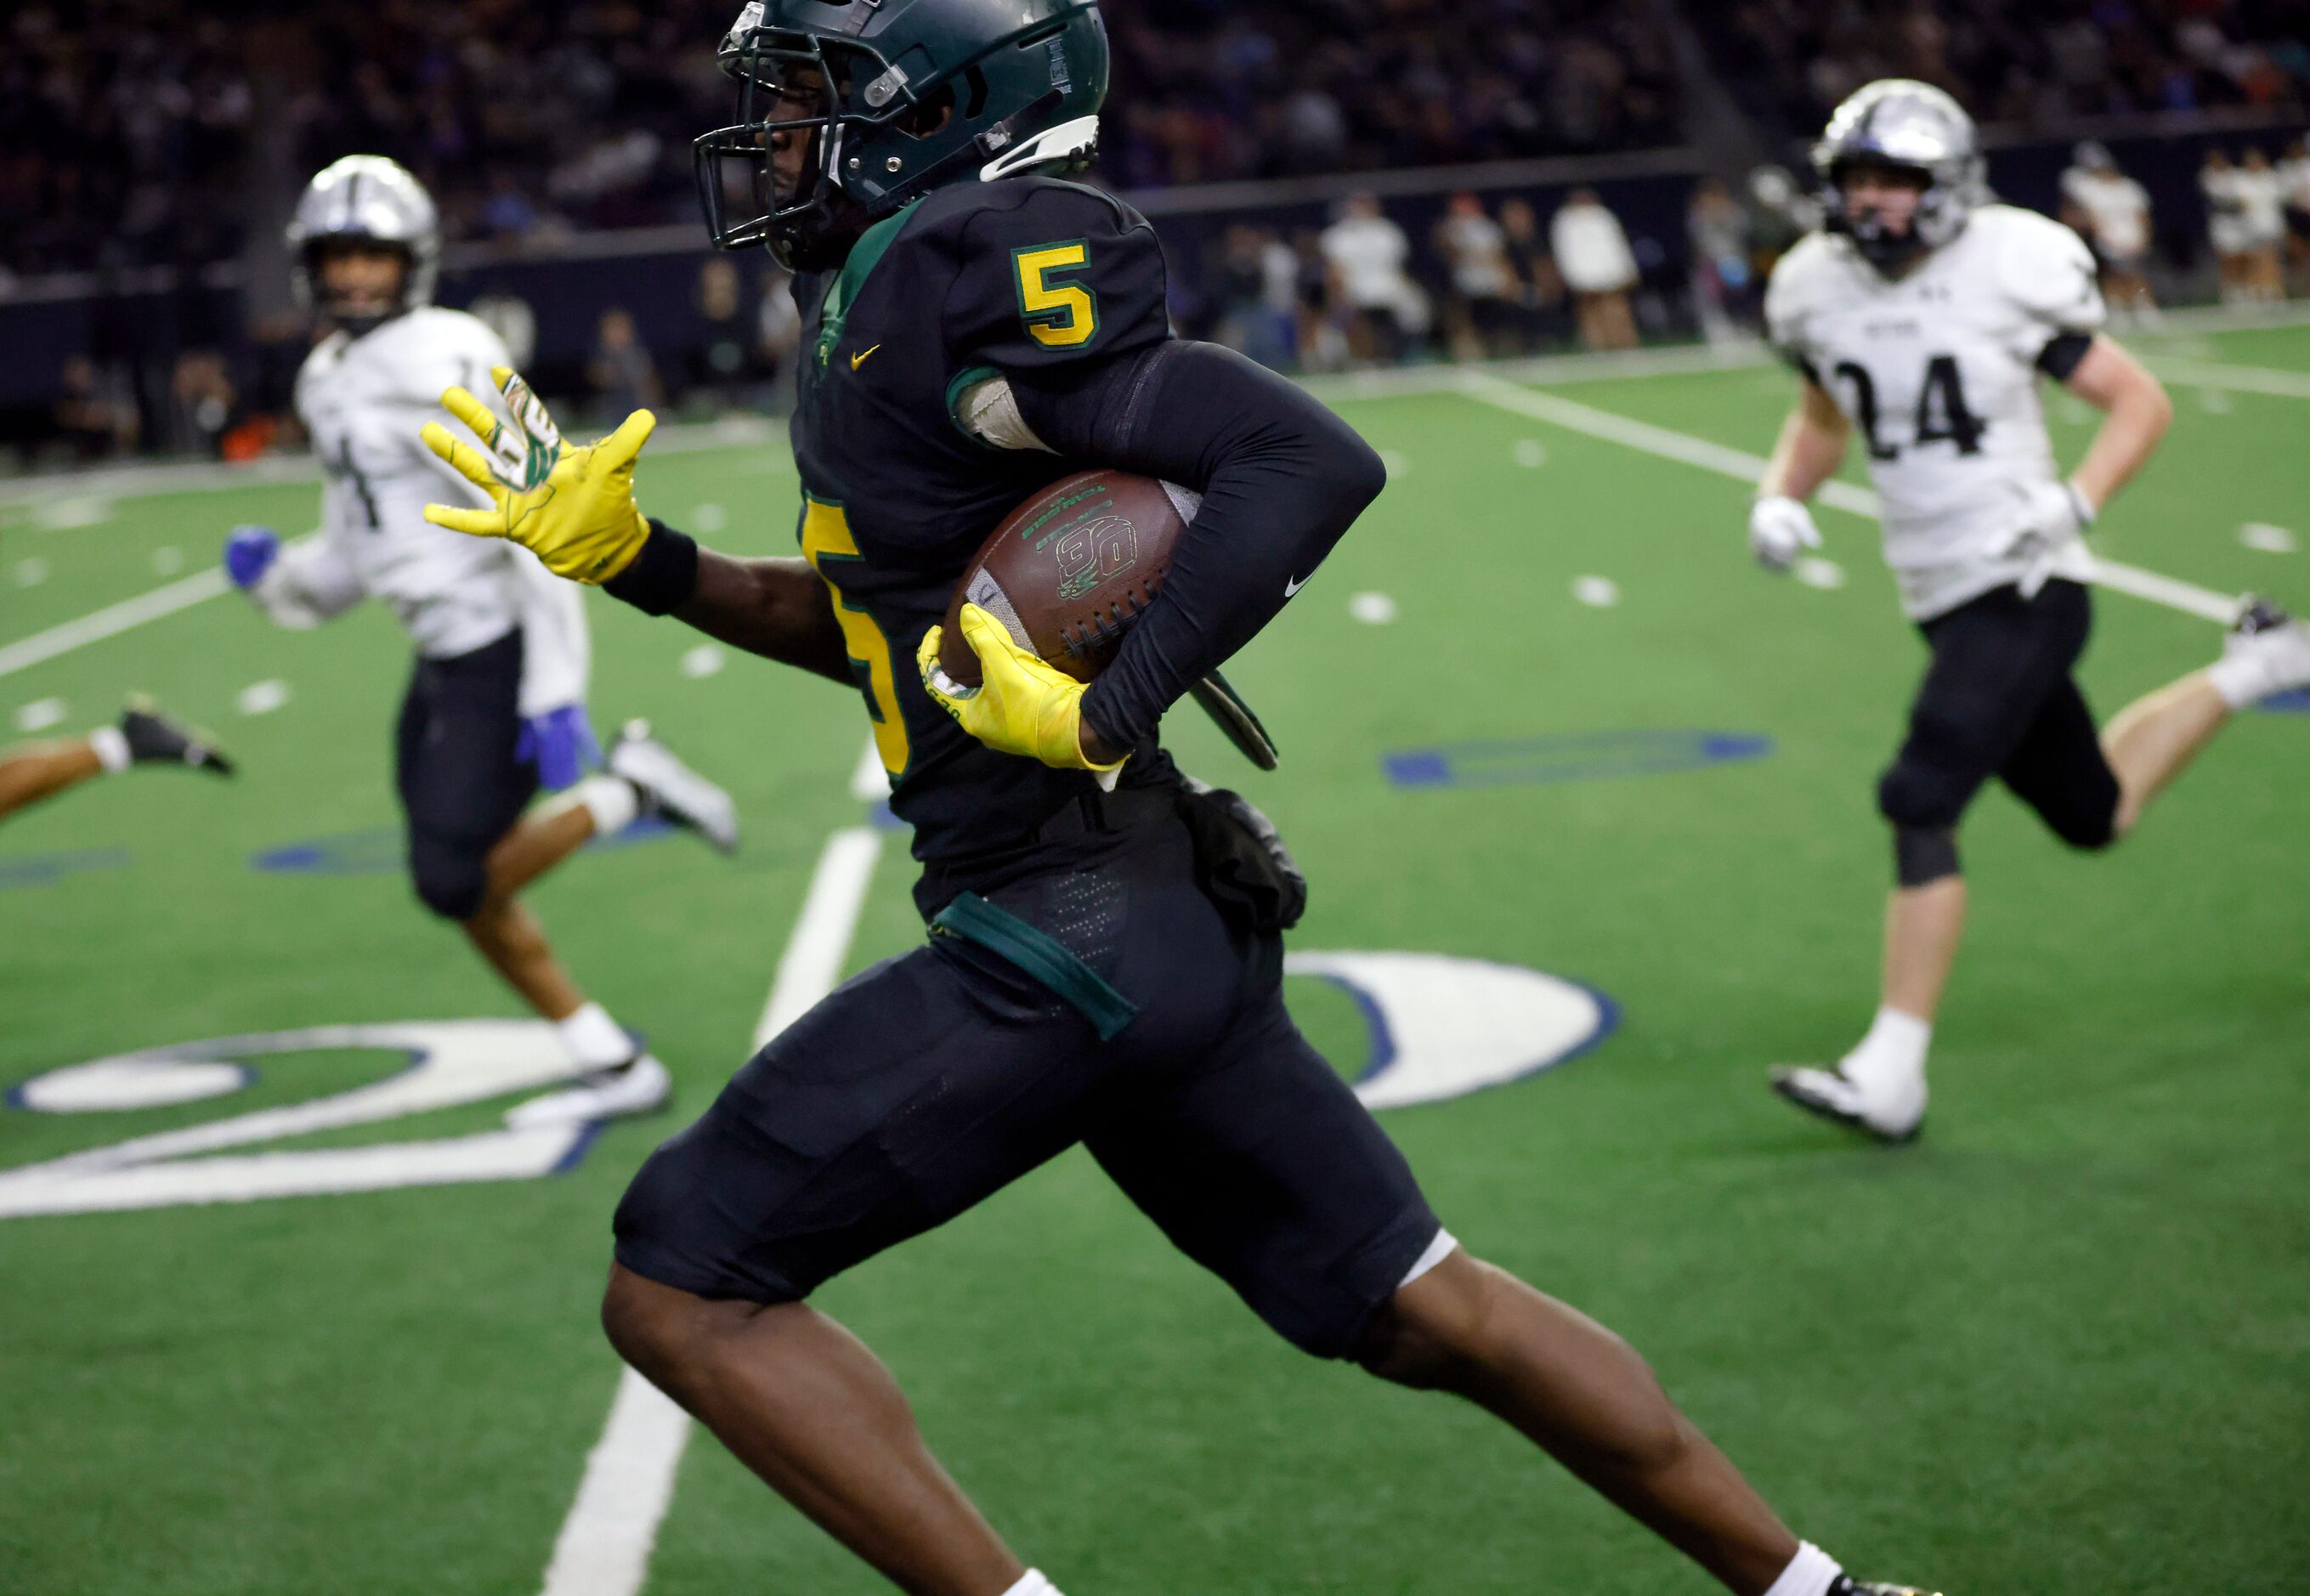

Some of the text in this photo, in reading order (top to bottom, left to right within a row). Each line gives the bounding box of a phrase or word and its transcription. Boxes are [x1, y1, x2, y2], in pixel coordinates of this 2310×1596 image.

[1011, 238, 1101, 353] 5
[1834, 353, 1989, 461] 24
[795, 490, 912, 784] 5
